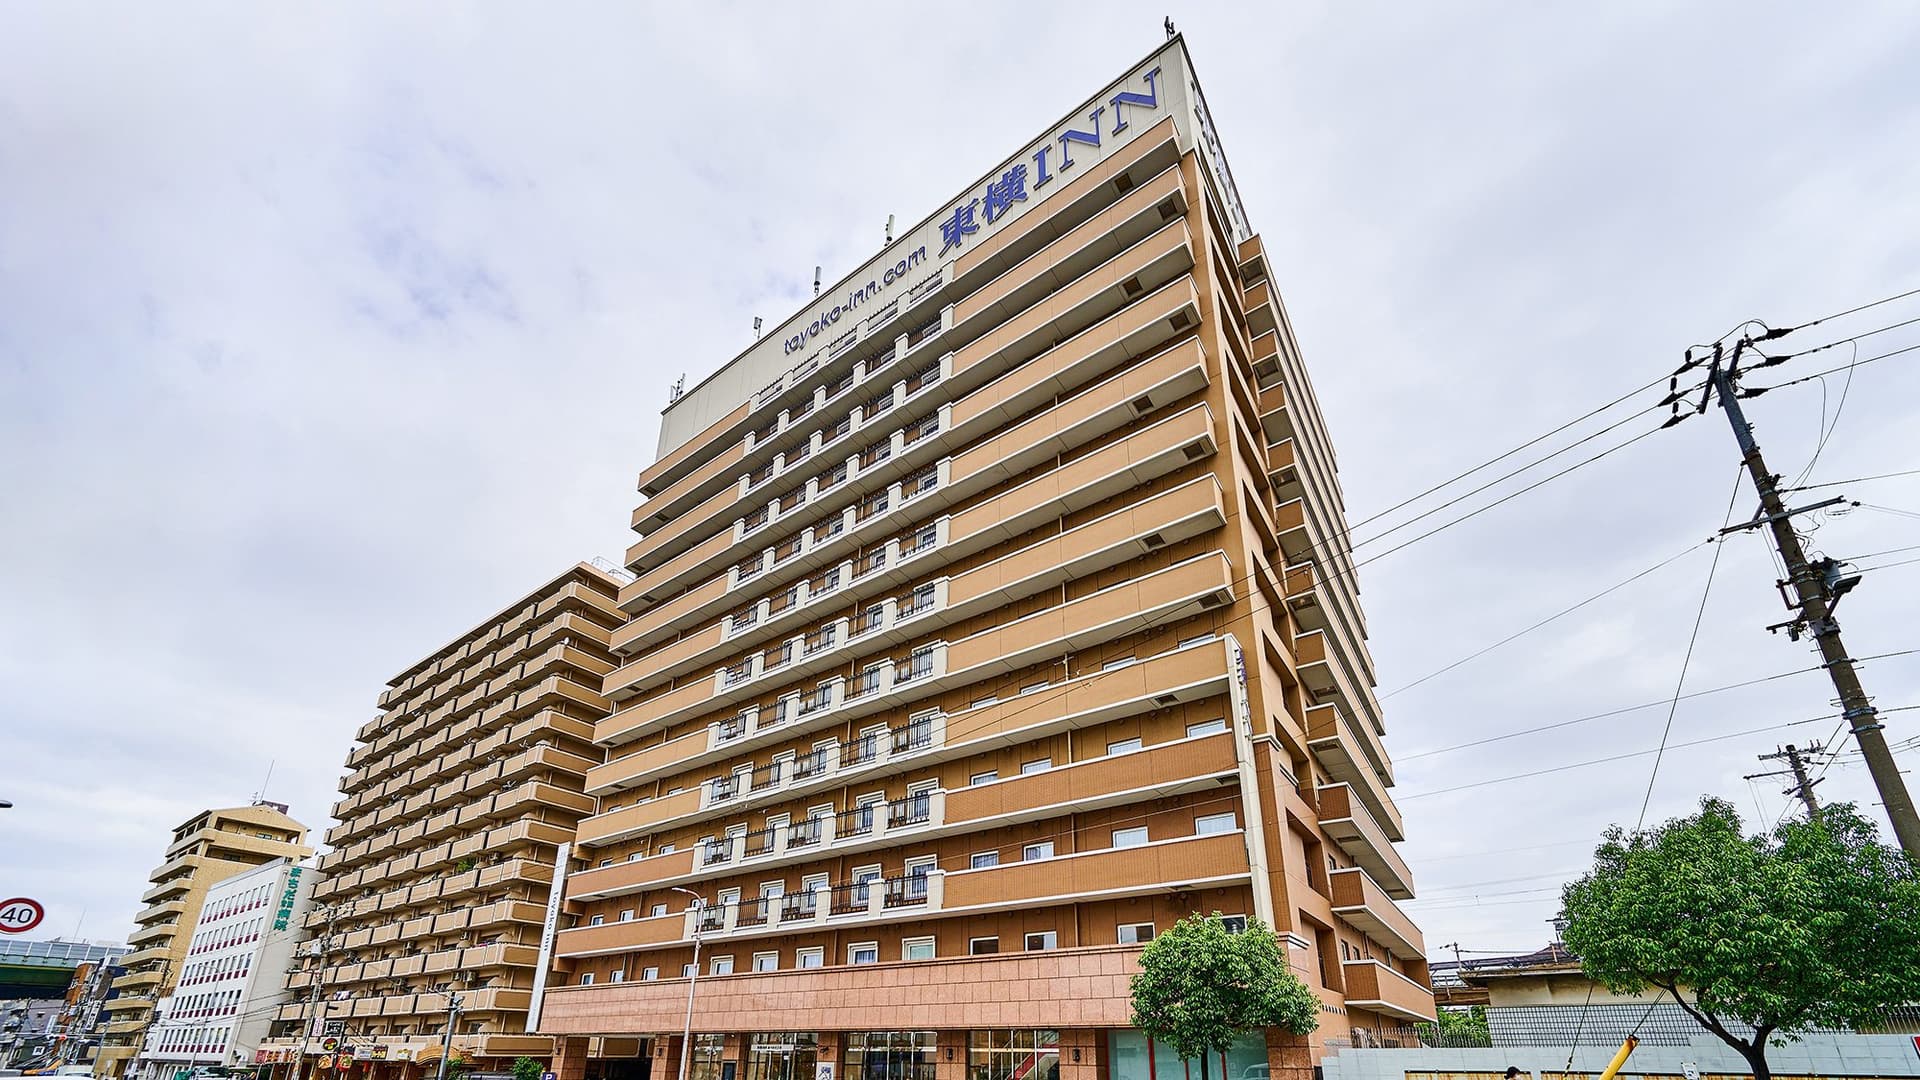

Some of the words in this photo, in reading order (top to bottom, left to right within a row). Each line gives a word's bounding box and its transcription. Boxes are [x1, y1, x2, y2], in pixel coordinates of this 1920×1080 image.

[939, 66, 1161, 259] 東横INN
[784, 246, 927, 355] toyoko-inn.com
[0, 907, 33, 924] 40
[546, 891, 559, 930] toyoko
